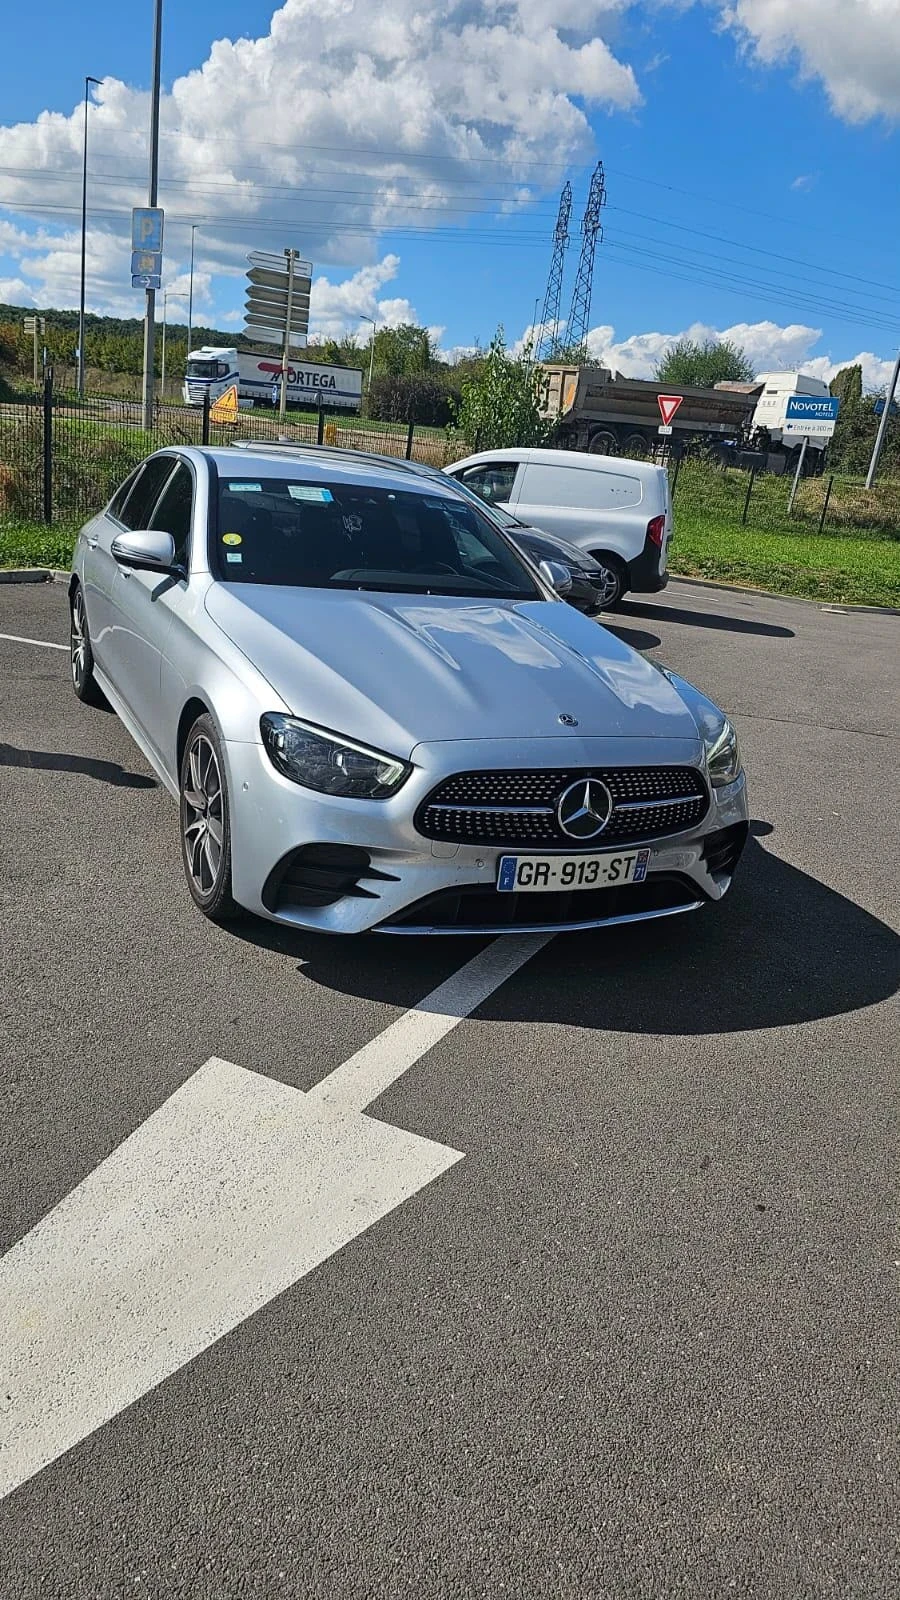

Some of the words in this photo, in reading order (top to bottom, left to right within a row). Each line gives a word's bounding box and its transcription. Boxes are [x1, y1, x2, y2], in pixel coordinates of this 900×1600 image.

[141, 217, 154, 242] P
[287, 370, 336, 389] ORTEGA
[790, 401, 834, 412] NOVOTEL
[504, 877, 510, 885] F
[517, 856, 636, 886] GR-913-ST
[634, 867, 645, 879] 71
